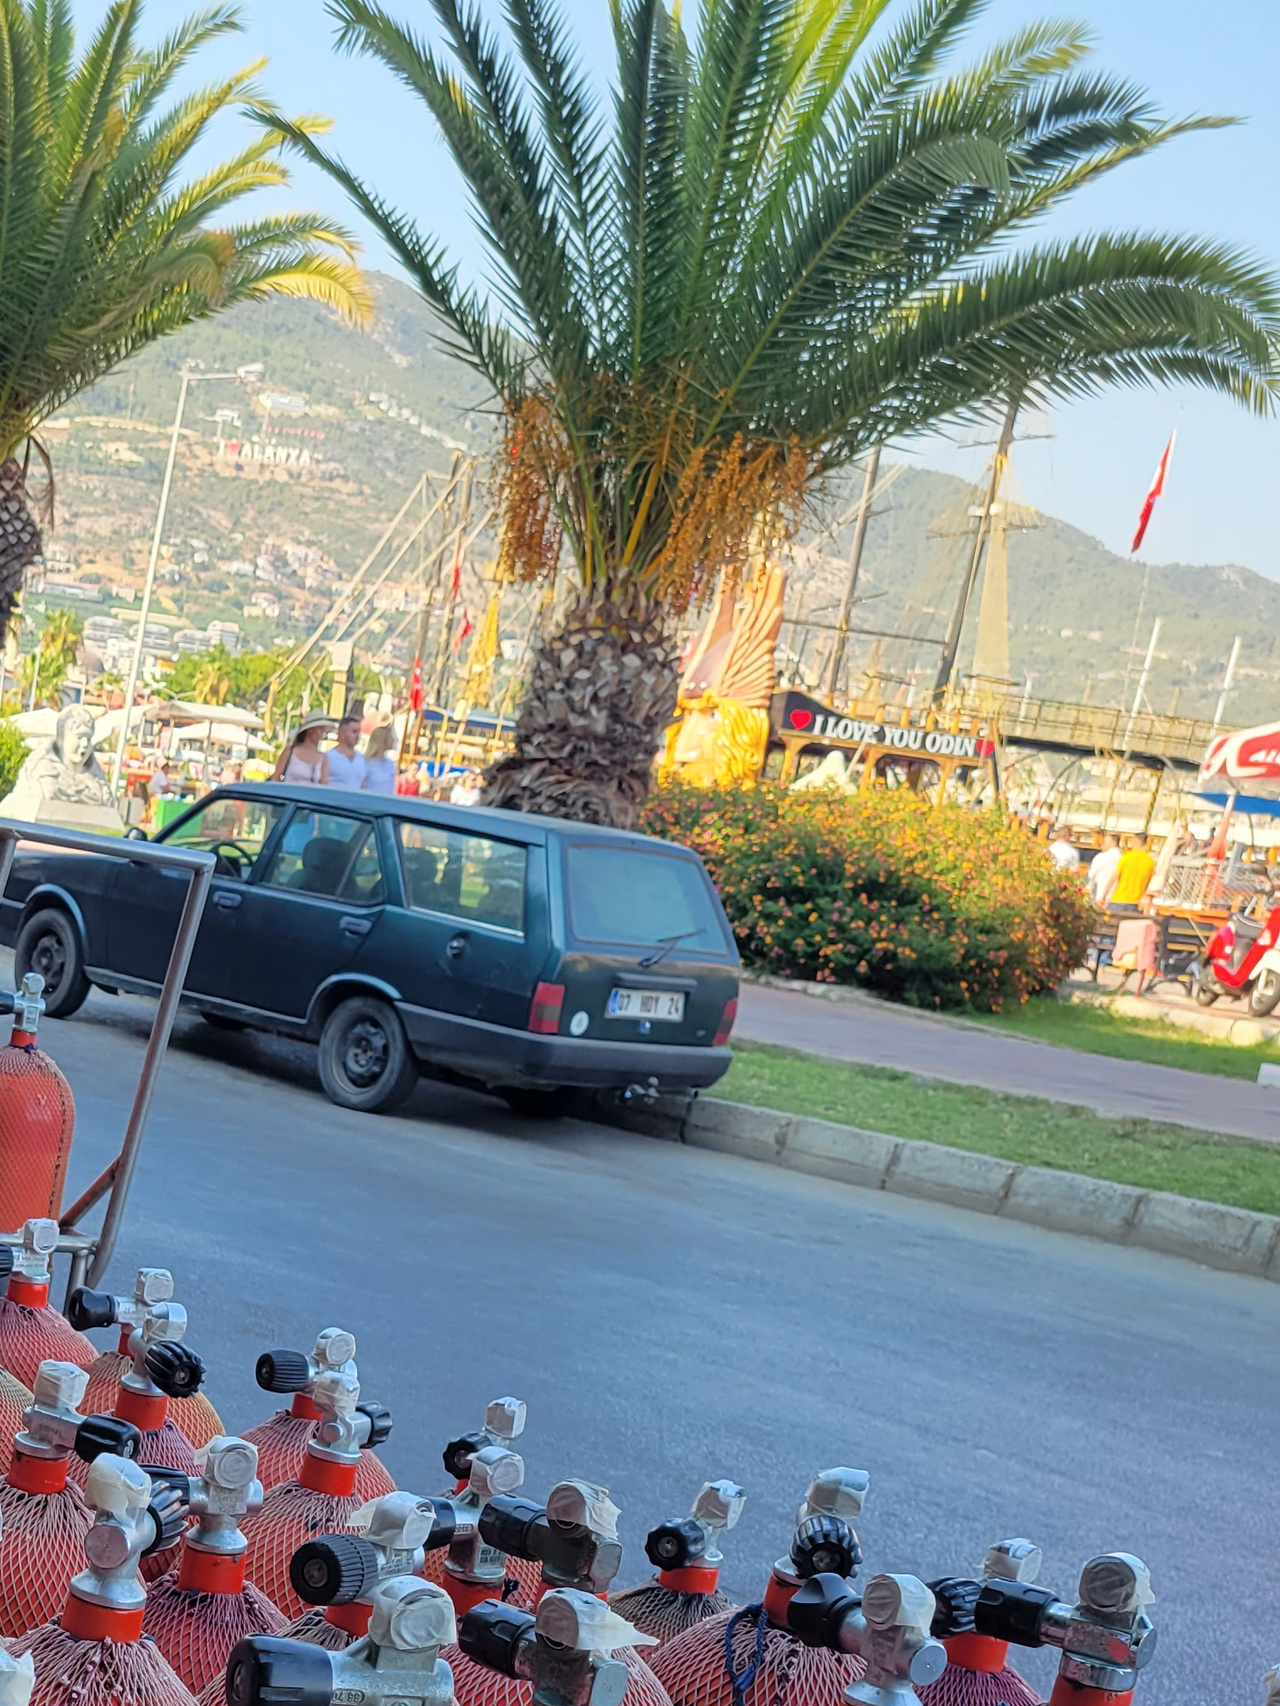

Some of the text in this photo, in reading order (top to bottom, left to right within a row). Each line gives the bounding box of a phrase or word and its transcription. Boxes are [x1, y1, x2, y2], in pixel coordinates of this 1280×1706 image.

[813, 714, 977, 758] I LOVE YOU ODIN
